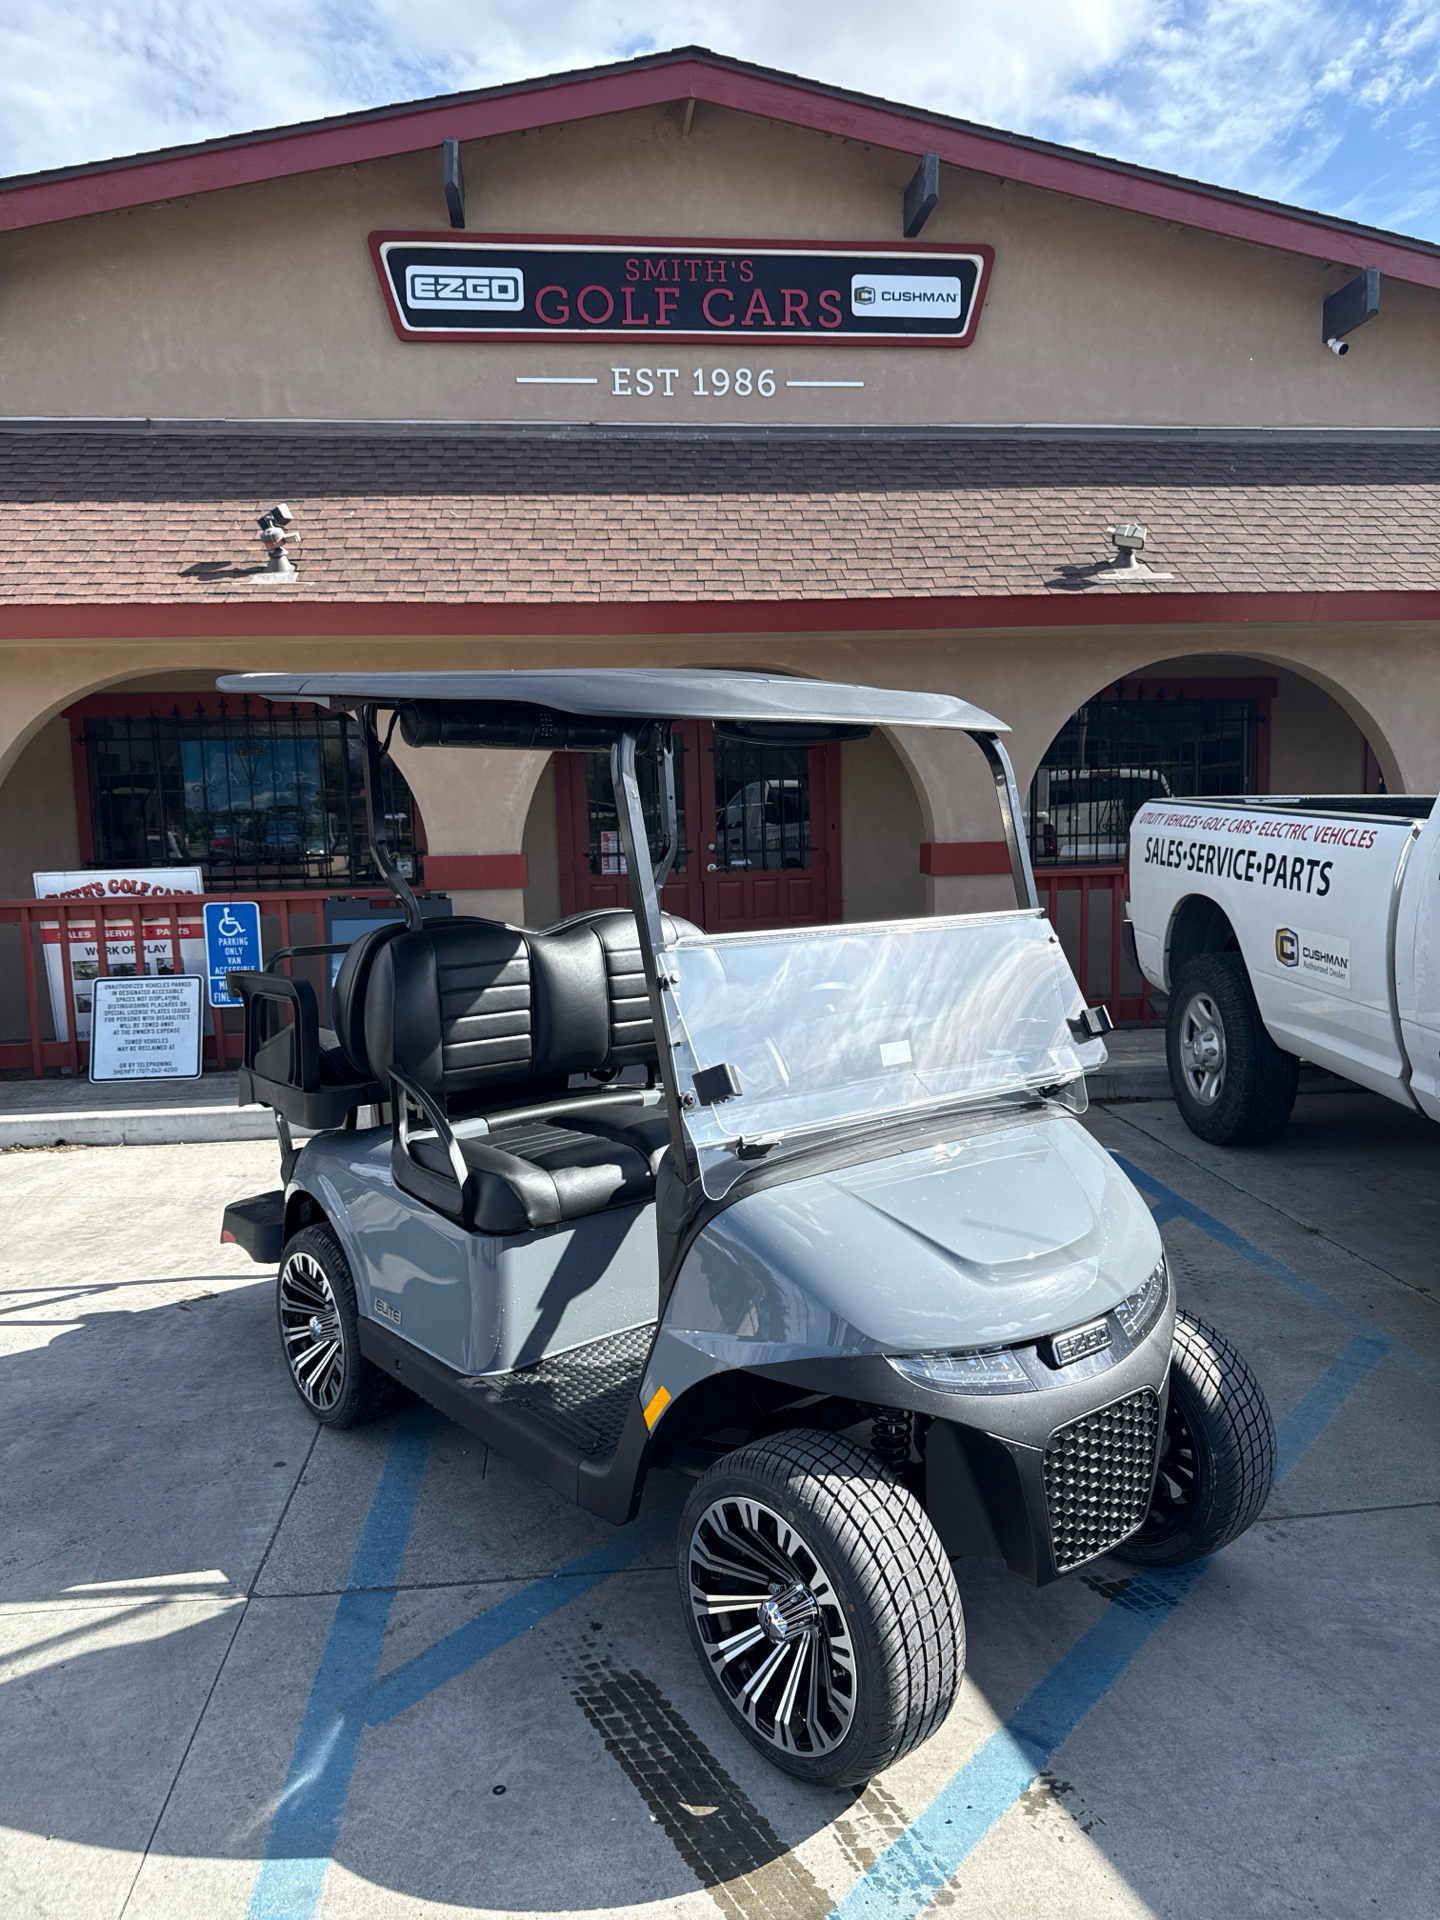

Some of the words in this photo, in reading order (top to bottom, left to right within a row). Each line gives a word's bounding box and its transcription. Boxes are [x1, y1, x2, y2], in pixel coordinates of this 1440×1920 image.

[625, 258, 754, 283] SMITH'S
[413, 276, 516, 301] EZGO
[881, 291, 957, 302] CUSHMAN
[535, 284, 680, 325] GOLF
[702, 288, 842, 328] CARS
[611, 368, 679, 396] EST
[693, 368, 776, 396] 1986
[1139, 812, 1167, 825] UTILITY
[1164, 812, 1202, 828] VEHICLES
[1202, 816, 1230, 831] GOLF
[1228, 818, 1256, 834] CARS
[1258, 821, 1314, 841] ELECTRIC
[1314, 825, 1378, 849] VEHICLES
[1144, 836, 1184, 869] SALES
[1186, 842, 1258, 882] SERVICE
[1262, 852, 1334, 896] PARTS
[108, 878, 151, 896] GOLF
[58, 930, 92, 938] ALES
[156, 928, 190, 936] PATS
[218, 937, 249, 946] PARKING
[85, 946, 120, 956] WRK
[224, 947, 244, 956] ONLY
[227, 956, 242, 965] VAN
[1302, 946, 1348, 969] CUSHMAN
[1303, 960, 1328, 975] Authorized
[1330, 968, 1346, 980] Dealer
[376, 1300, 400, 1322] ELITE
[1058, 1324, 1110, 1359] EZGO
